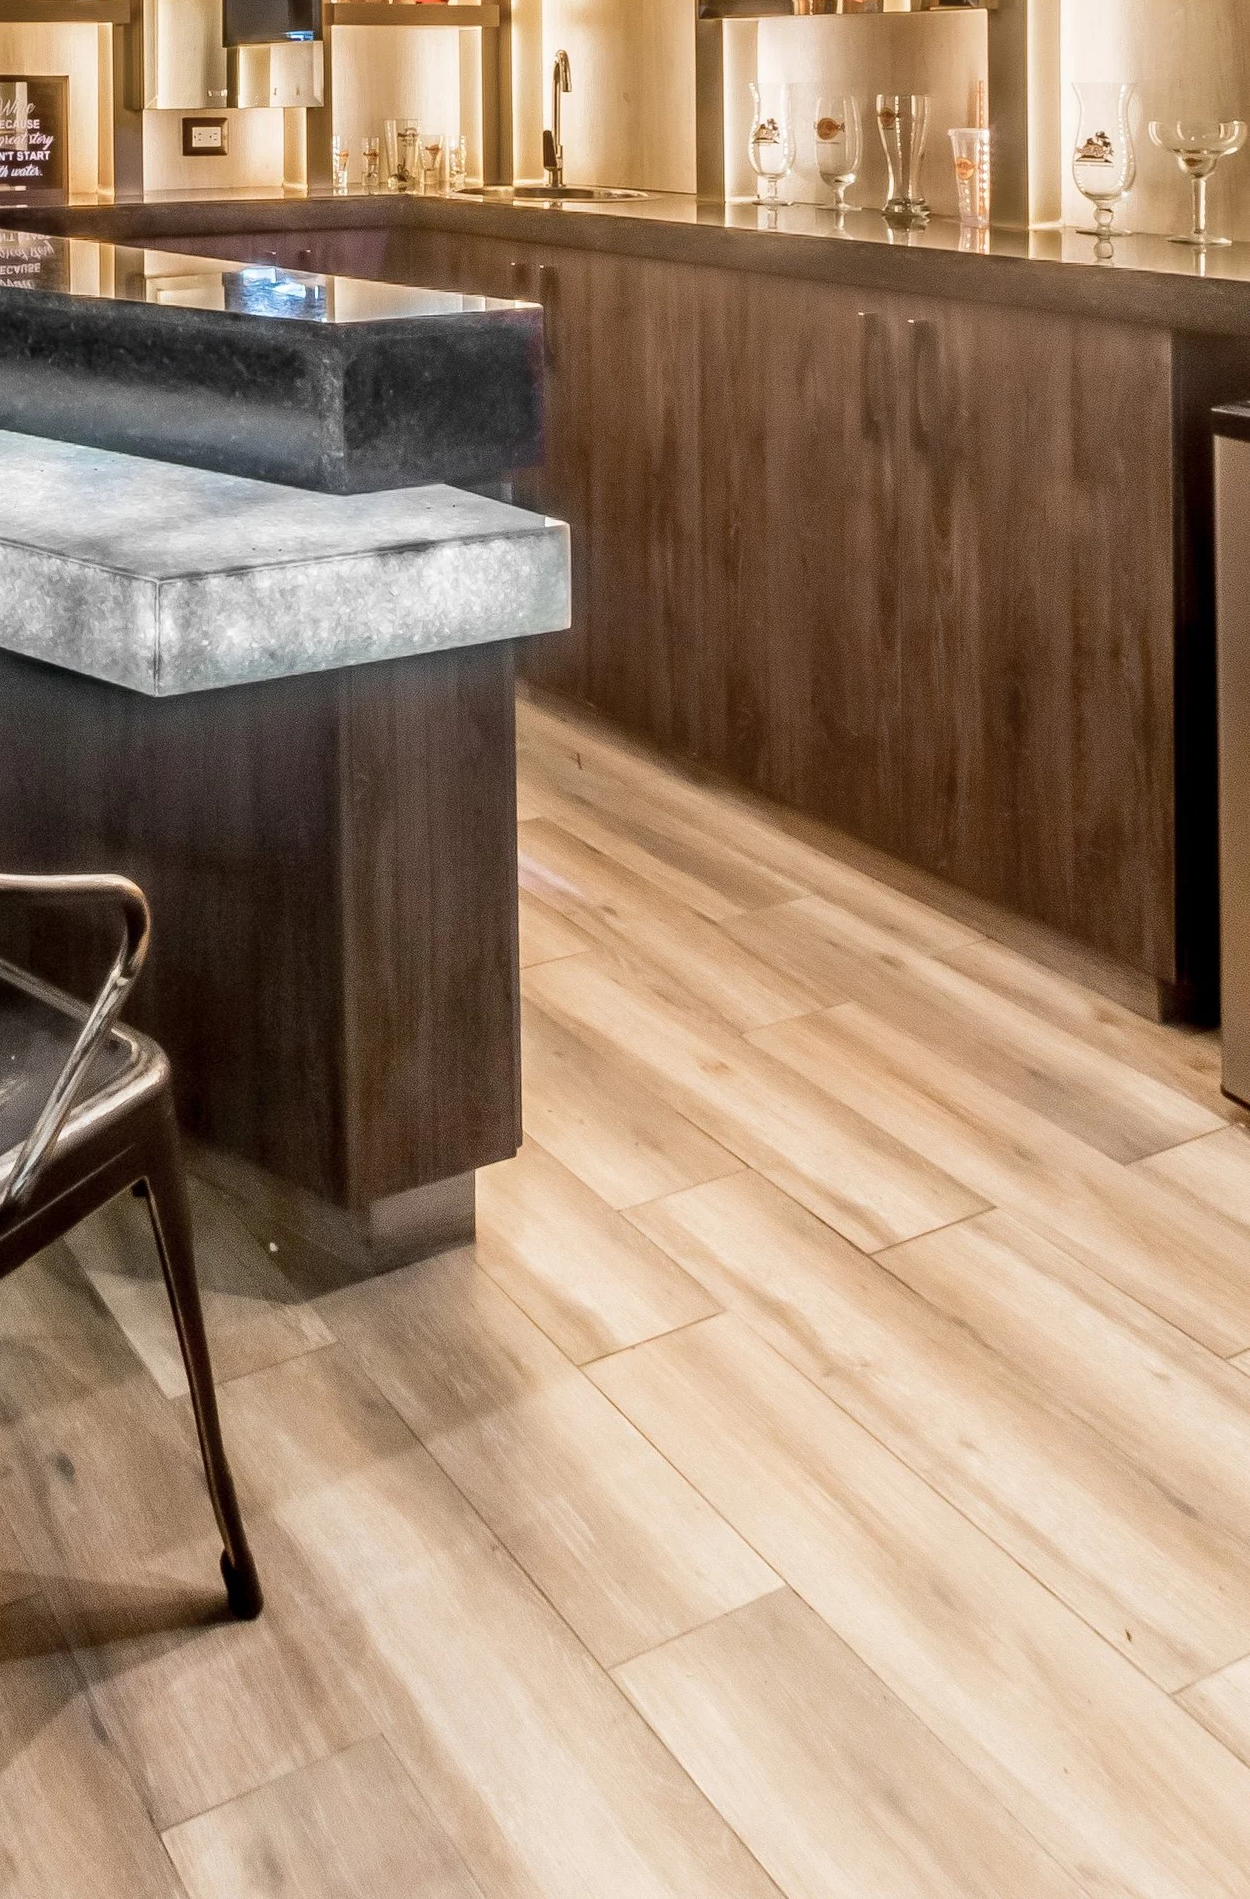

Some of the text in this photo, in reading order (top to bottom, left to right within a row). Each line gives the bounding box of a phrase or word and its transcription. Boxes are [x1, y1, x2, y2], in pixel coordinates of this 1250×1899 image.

[29, 131, 54, 151] story
[16, 151, 51, 161] START
[10, 163, 44, 178] water.
